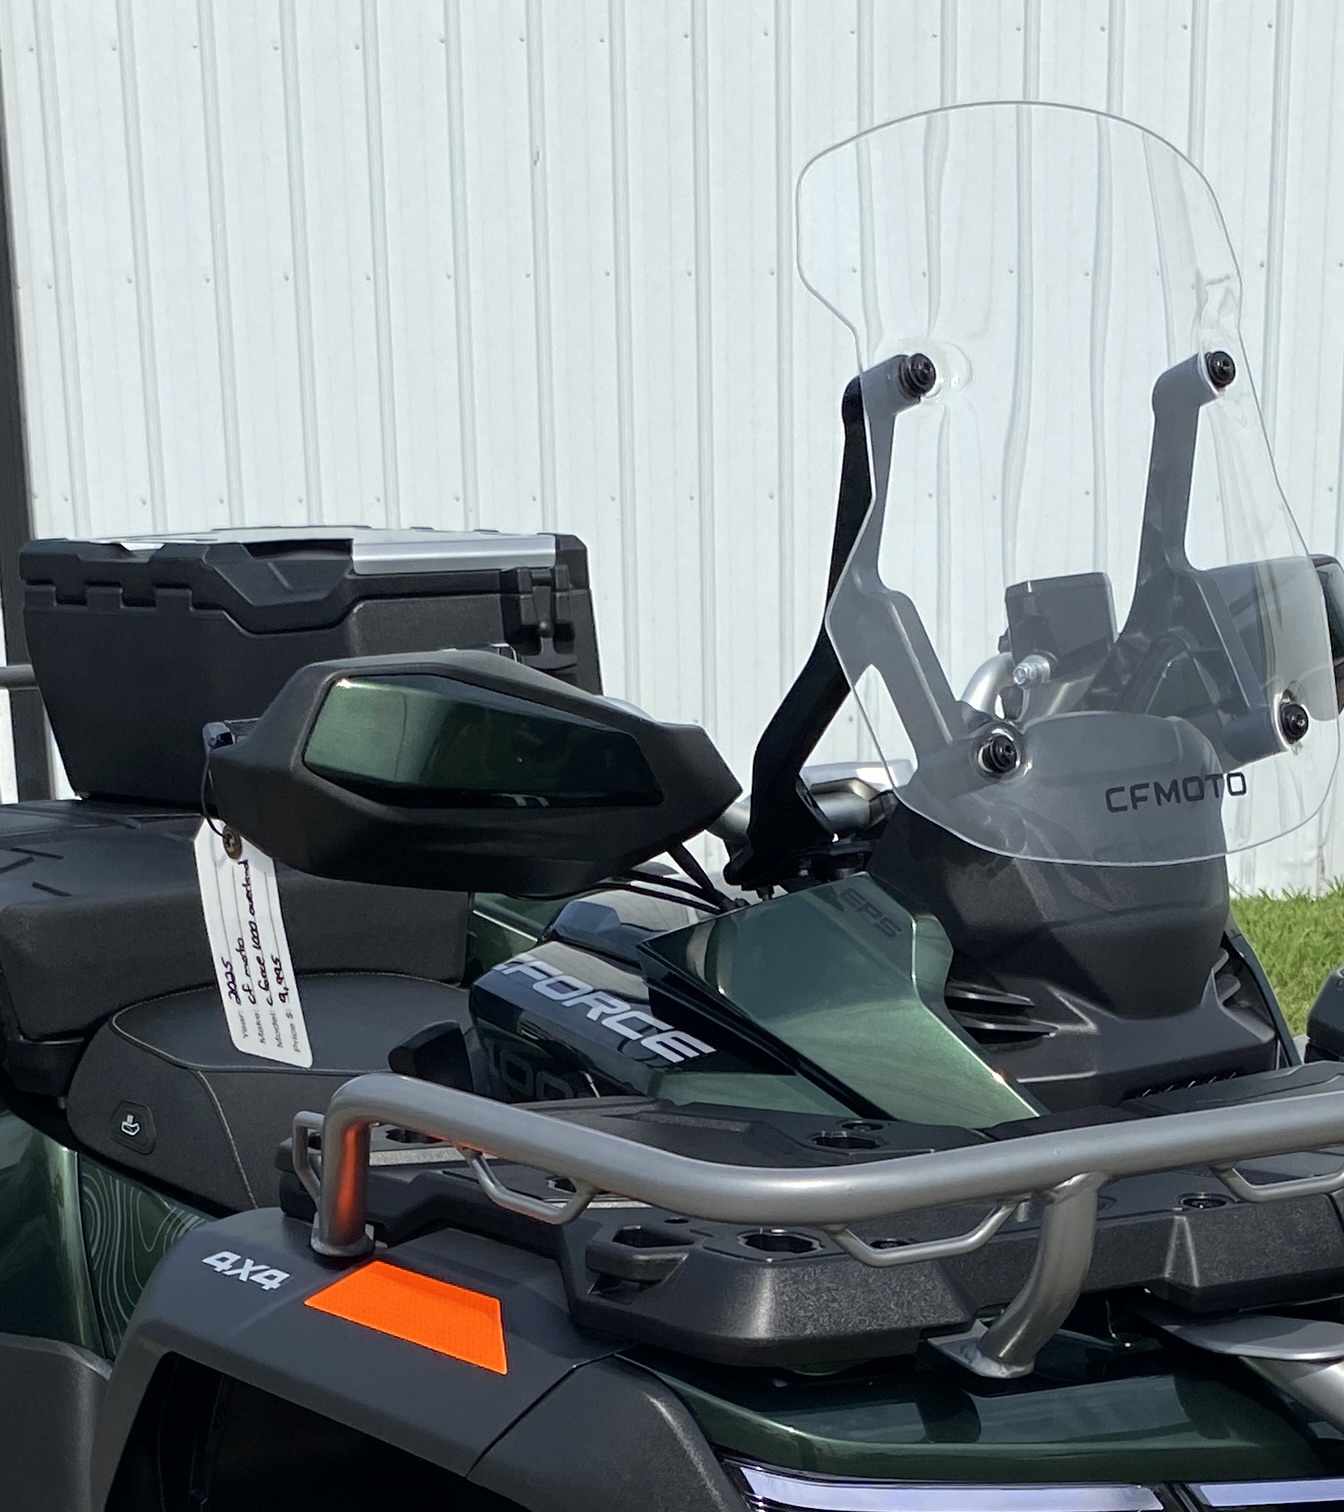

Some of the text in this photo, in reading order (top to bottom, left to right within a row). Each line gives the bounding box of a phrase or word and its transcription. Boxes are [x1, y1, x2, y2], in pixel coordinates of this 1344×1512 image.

[1105, 772, 1247, 813] CFMOTO
[839, 887, 903, 938] EPS
[221, 956, 241, 1006] 2025
